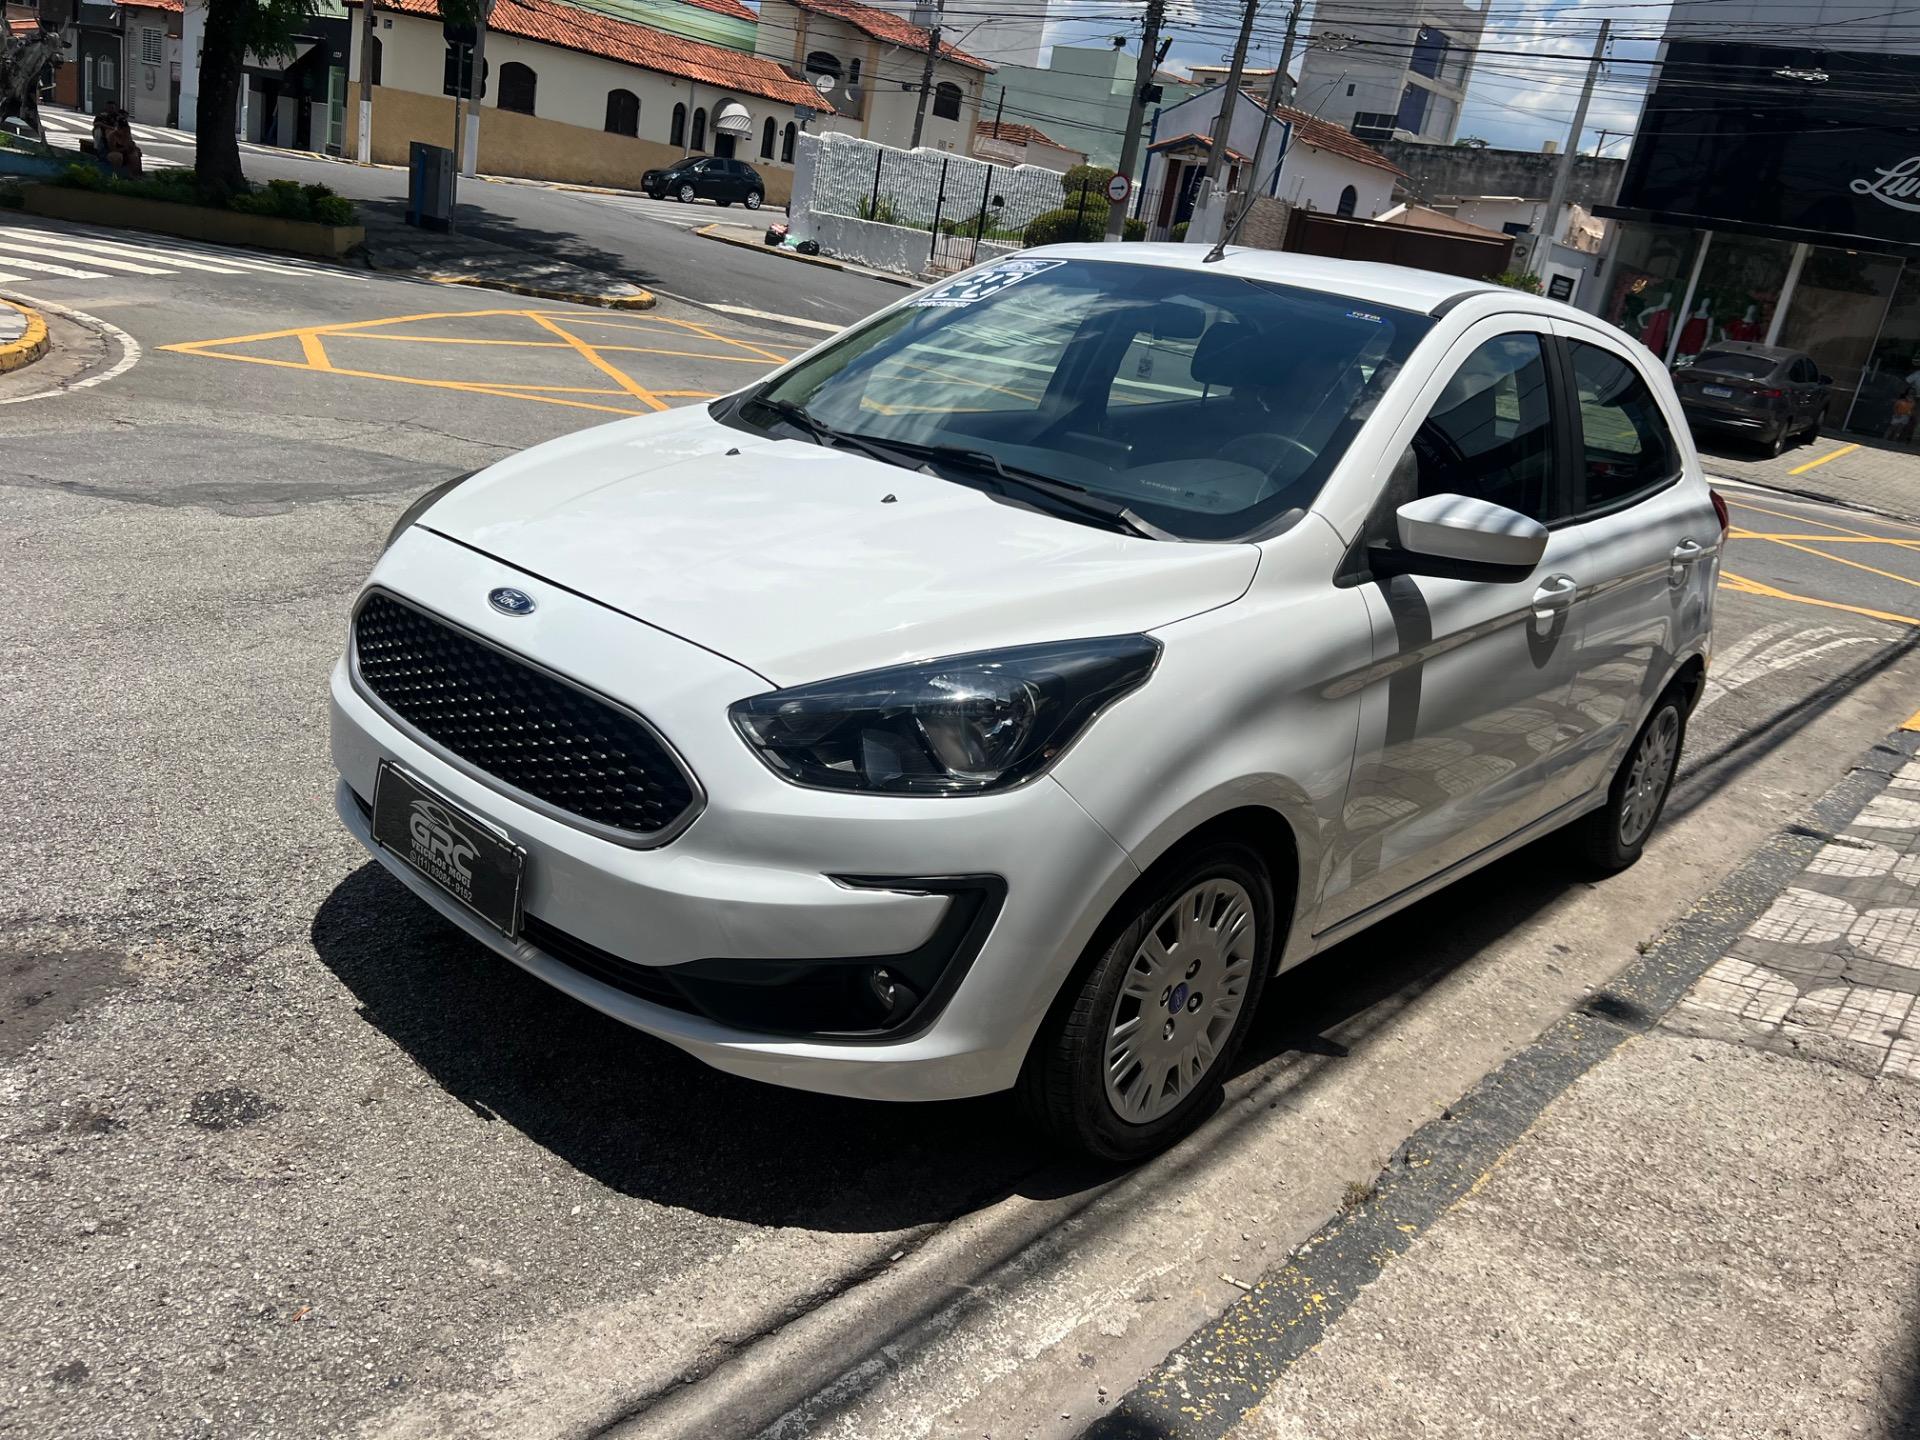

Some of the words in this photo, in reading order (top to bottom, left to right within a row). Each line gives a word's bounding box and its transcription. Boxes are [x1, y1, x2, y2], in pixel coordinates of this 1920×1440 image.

[1849, 156, 1920, 213] Lu
[409, 812, 474, 880] GRC
[411, 838, 447, 871] VEICULOS
[448, 866, 471, 889] MOGI
